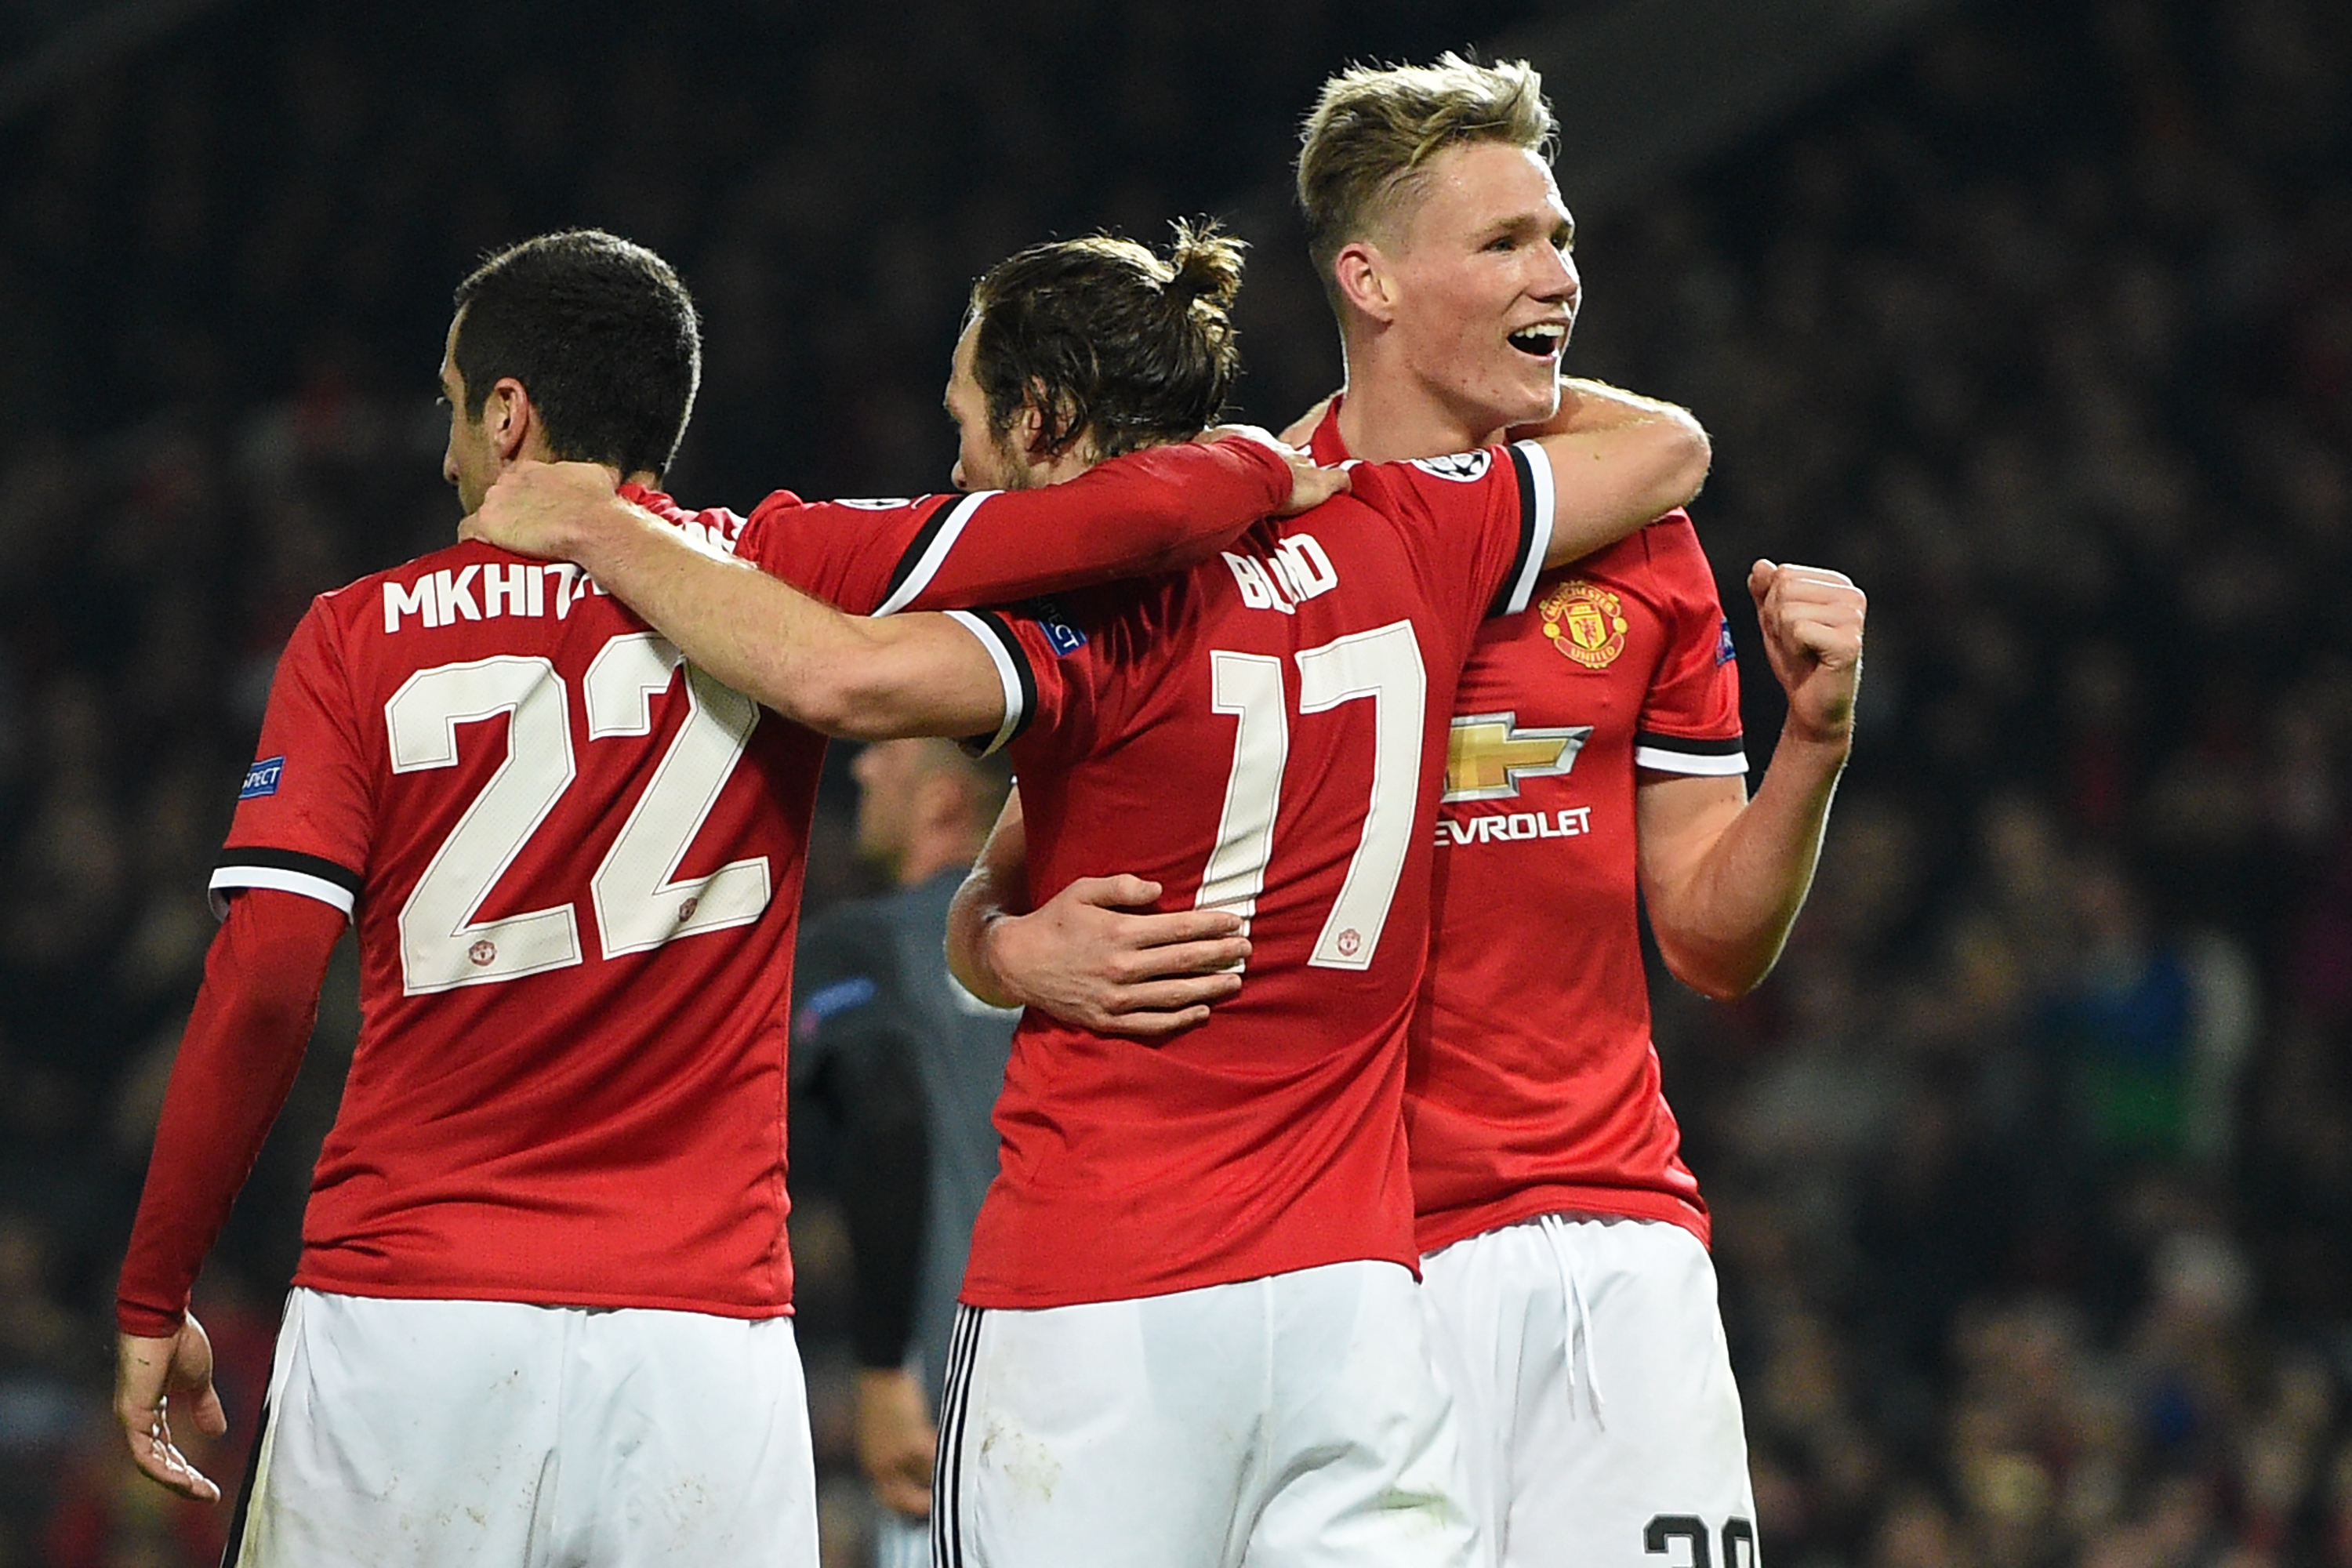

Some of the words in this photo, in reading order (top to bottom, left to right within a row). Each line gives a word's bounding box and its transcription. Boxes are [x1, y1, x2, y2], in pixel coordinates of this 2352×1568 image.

[385, 632, 771, 996] 22
[1194, 619, 1426, 973] 17
[1570, 646, 1615, 662] UNITED
